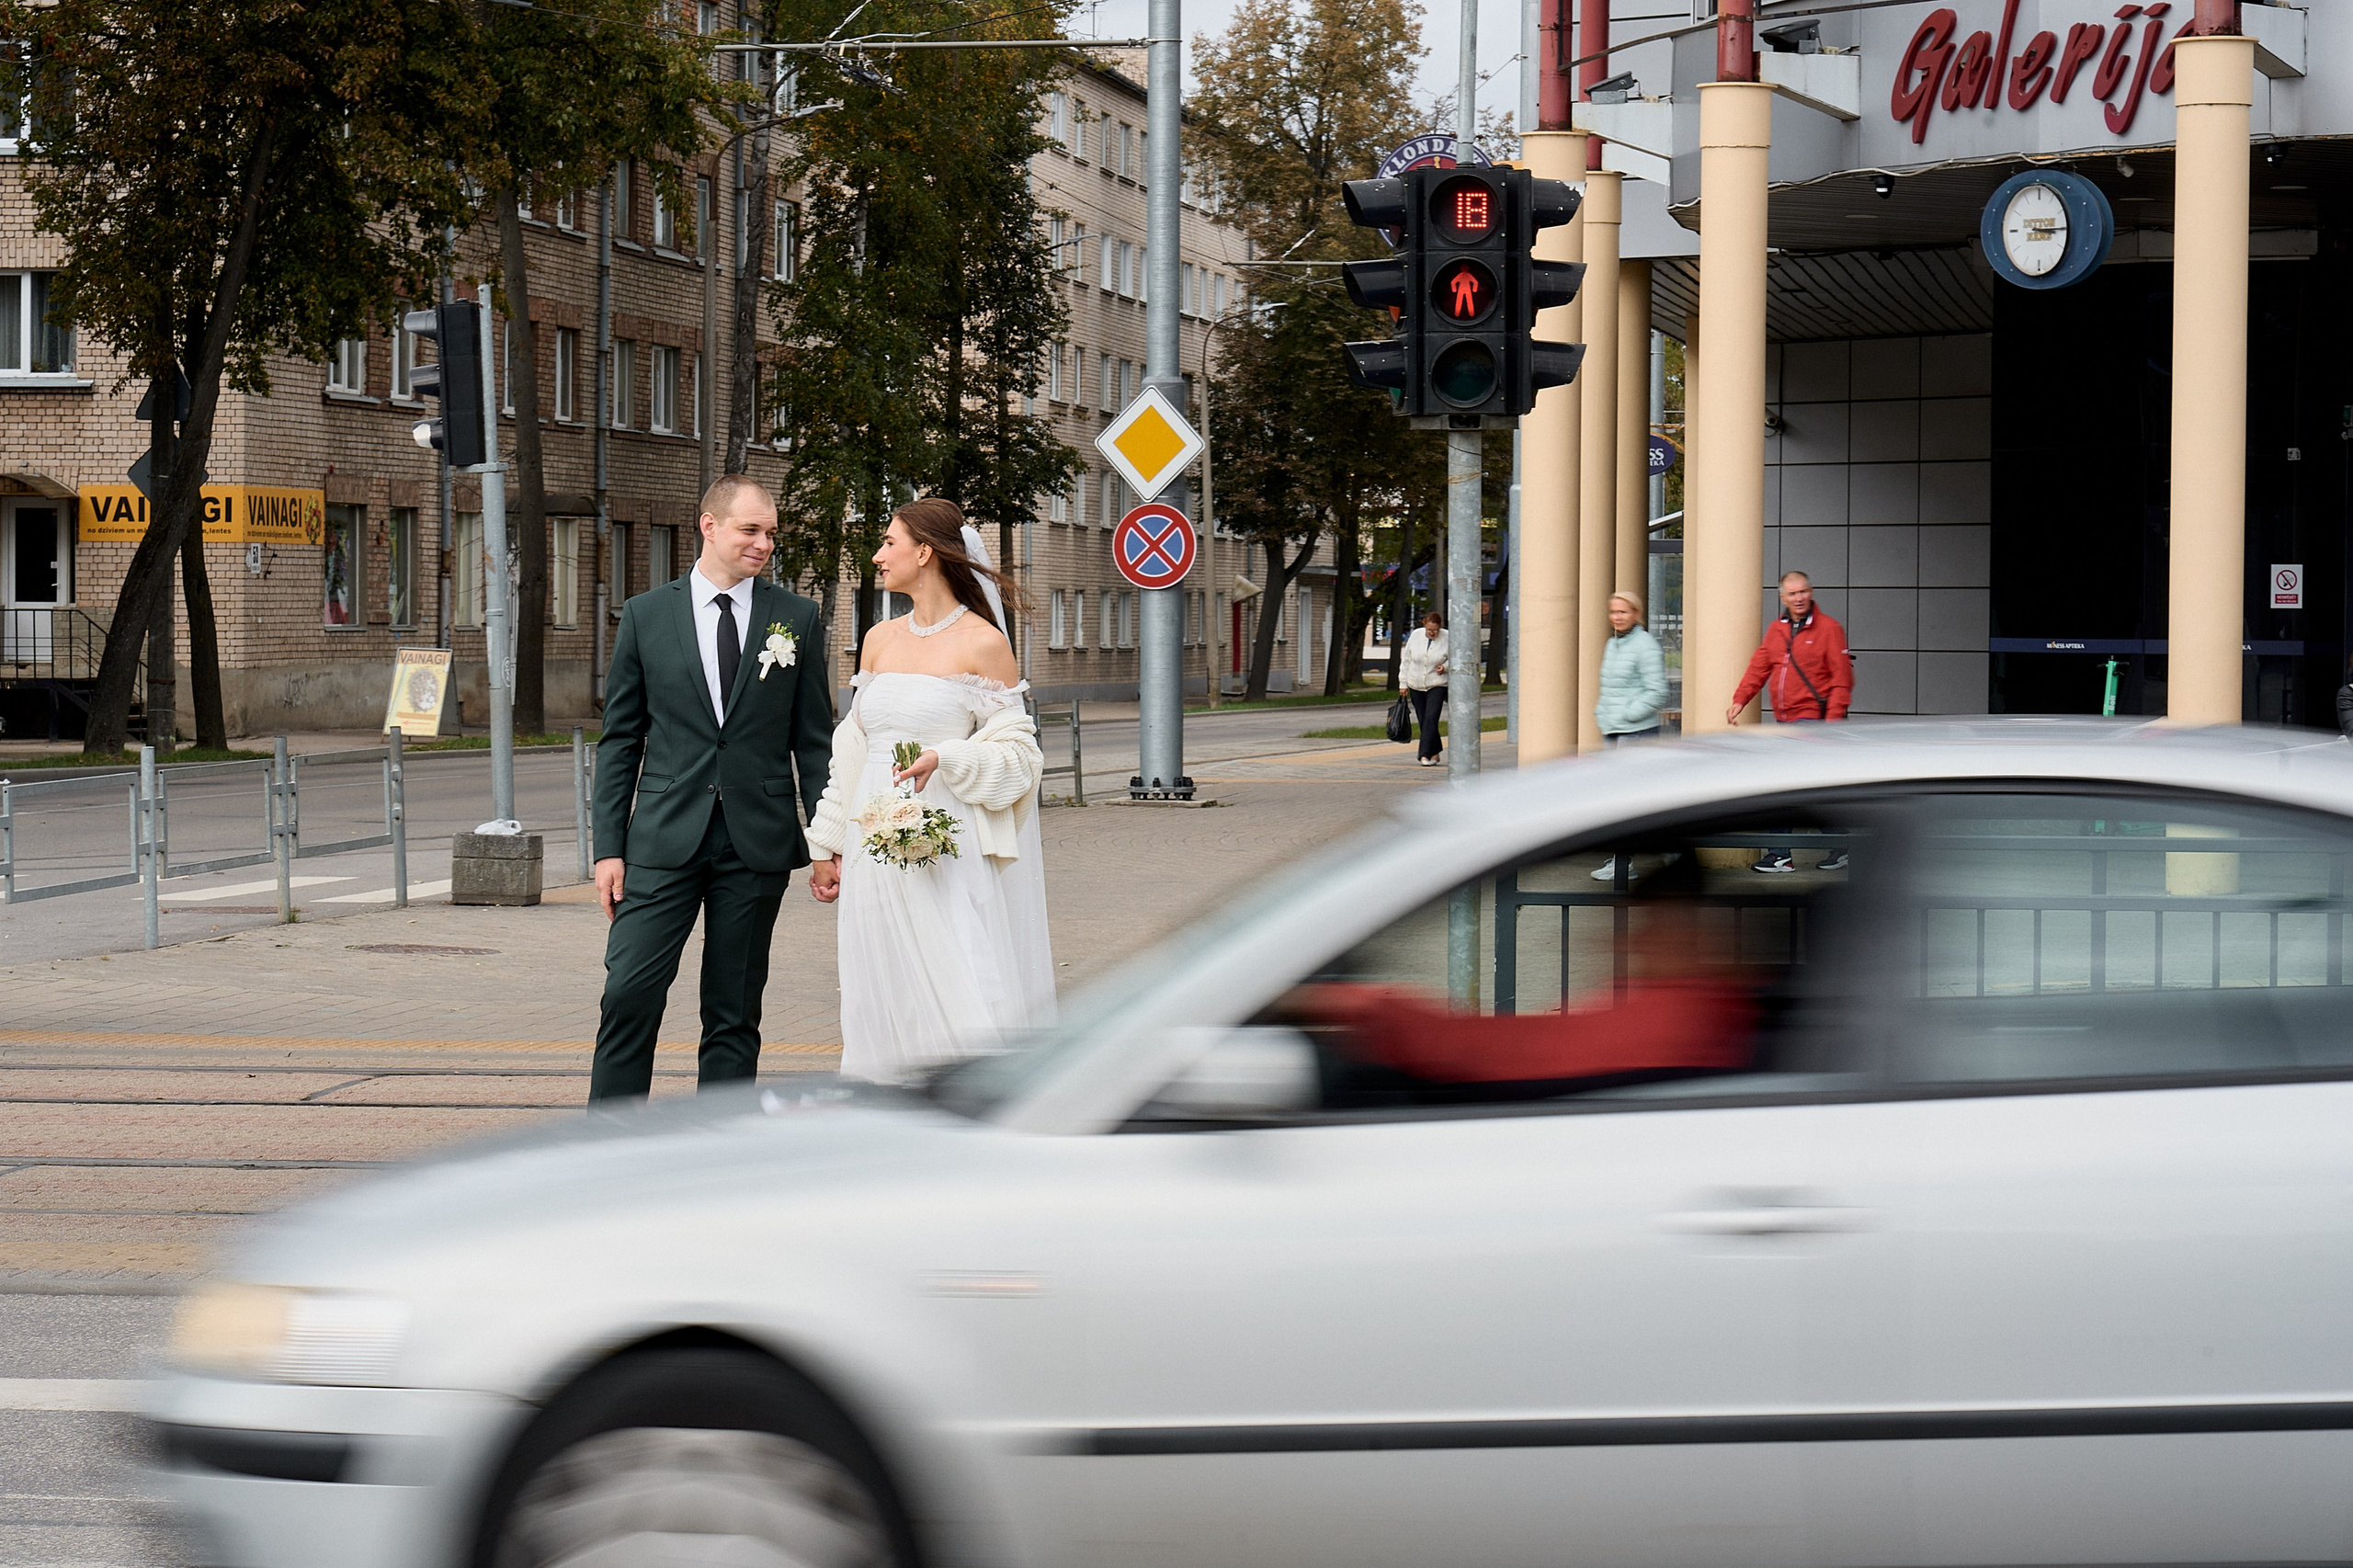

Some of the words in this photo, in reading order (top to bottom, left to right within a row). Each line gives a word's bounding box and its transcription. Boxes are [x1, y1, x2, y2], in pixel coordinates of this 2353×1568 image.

[1457, 192, 1488, 228] 18
[90, 496, 233, 523] VAIGI
[247, 494, 302, 528] VAINAGI
[400, 653, 447, 665] VAINAGI
